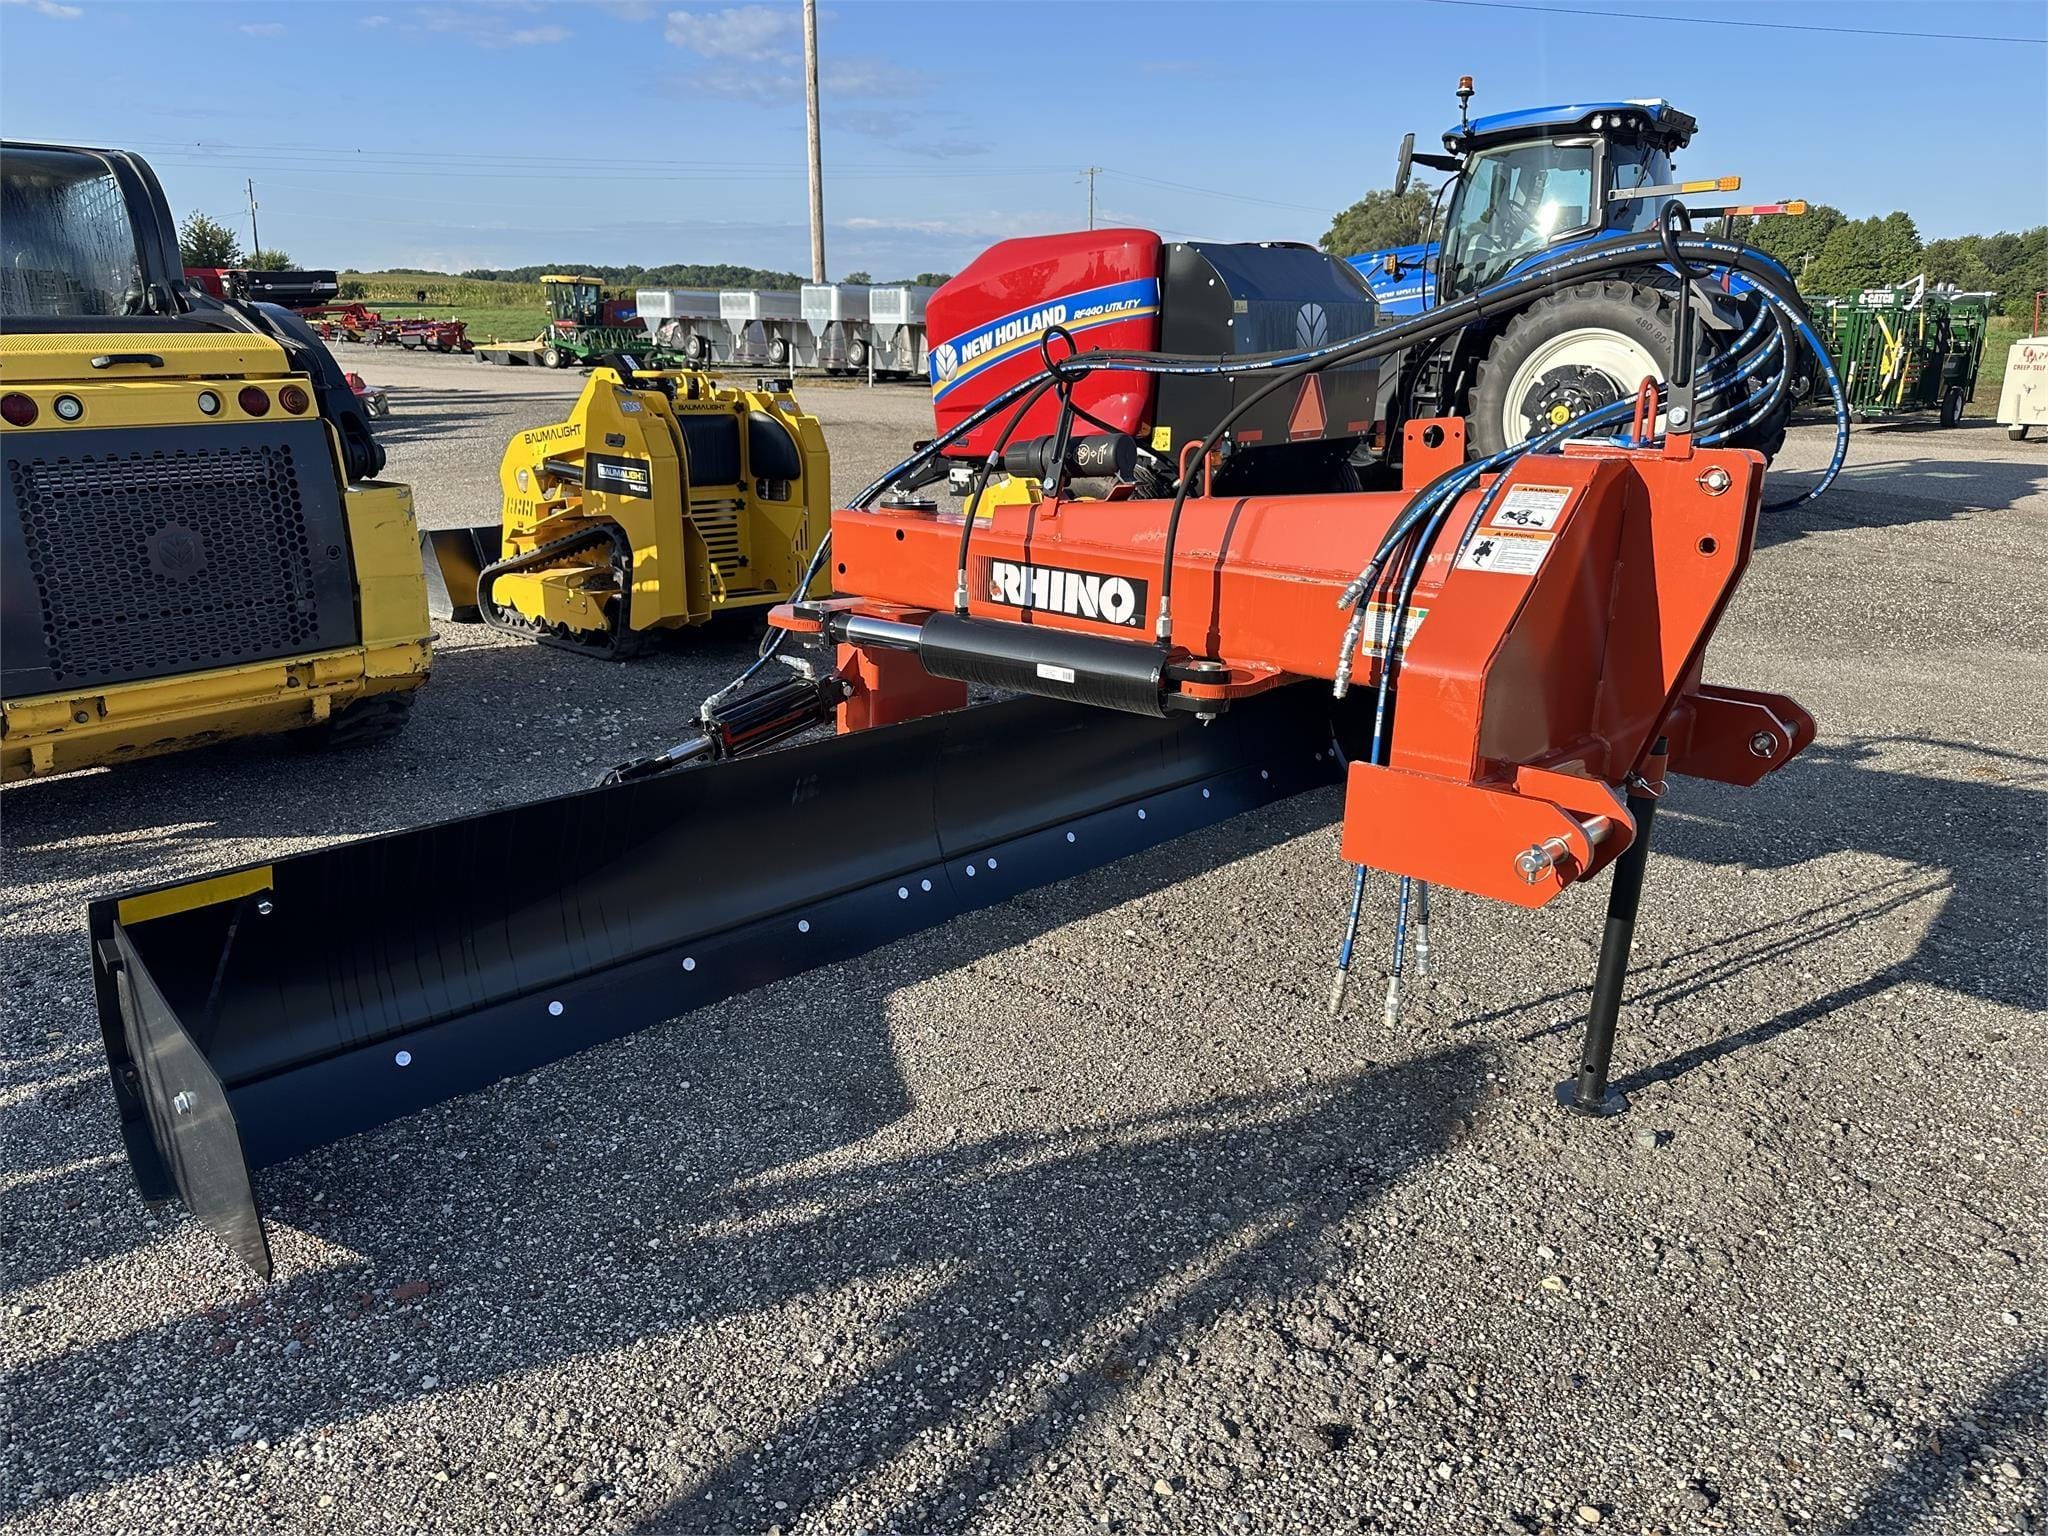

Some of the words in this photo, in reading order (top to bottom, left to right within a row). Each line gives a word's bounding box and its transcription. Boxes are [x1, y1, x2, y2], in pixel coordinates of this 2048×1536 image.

[1859, 293, 1895, 304] Q-CATCH
[961, 331, 993, 364] NEW
[995, 304, 1067, 345] HOLLAND
[1073, 305, 1104, 320] RF440
[1104, 298, 1141, 313] UTILITY
[1635, 317, 1668, 345] 480/80
[524, 424, 582, 445] BAUMALIGHT
[600, 466, 645, 480] BAUMALIGHT
[991, 561, 1136, 625] RHINO
